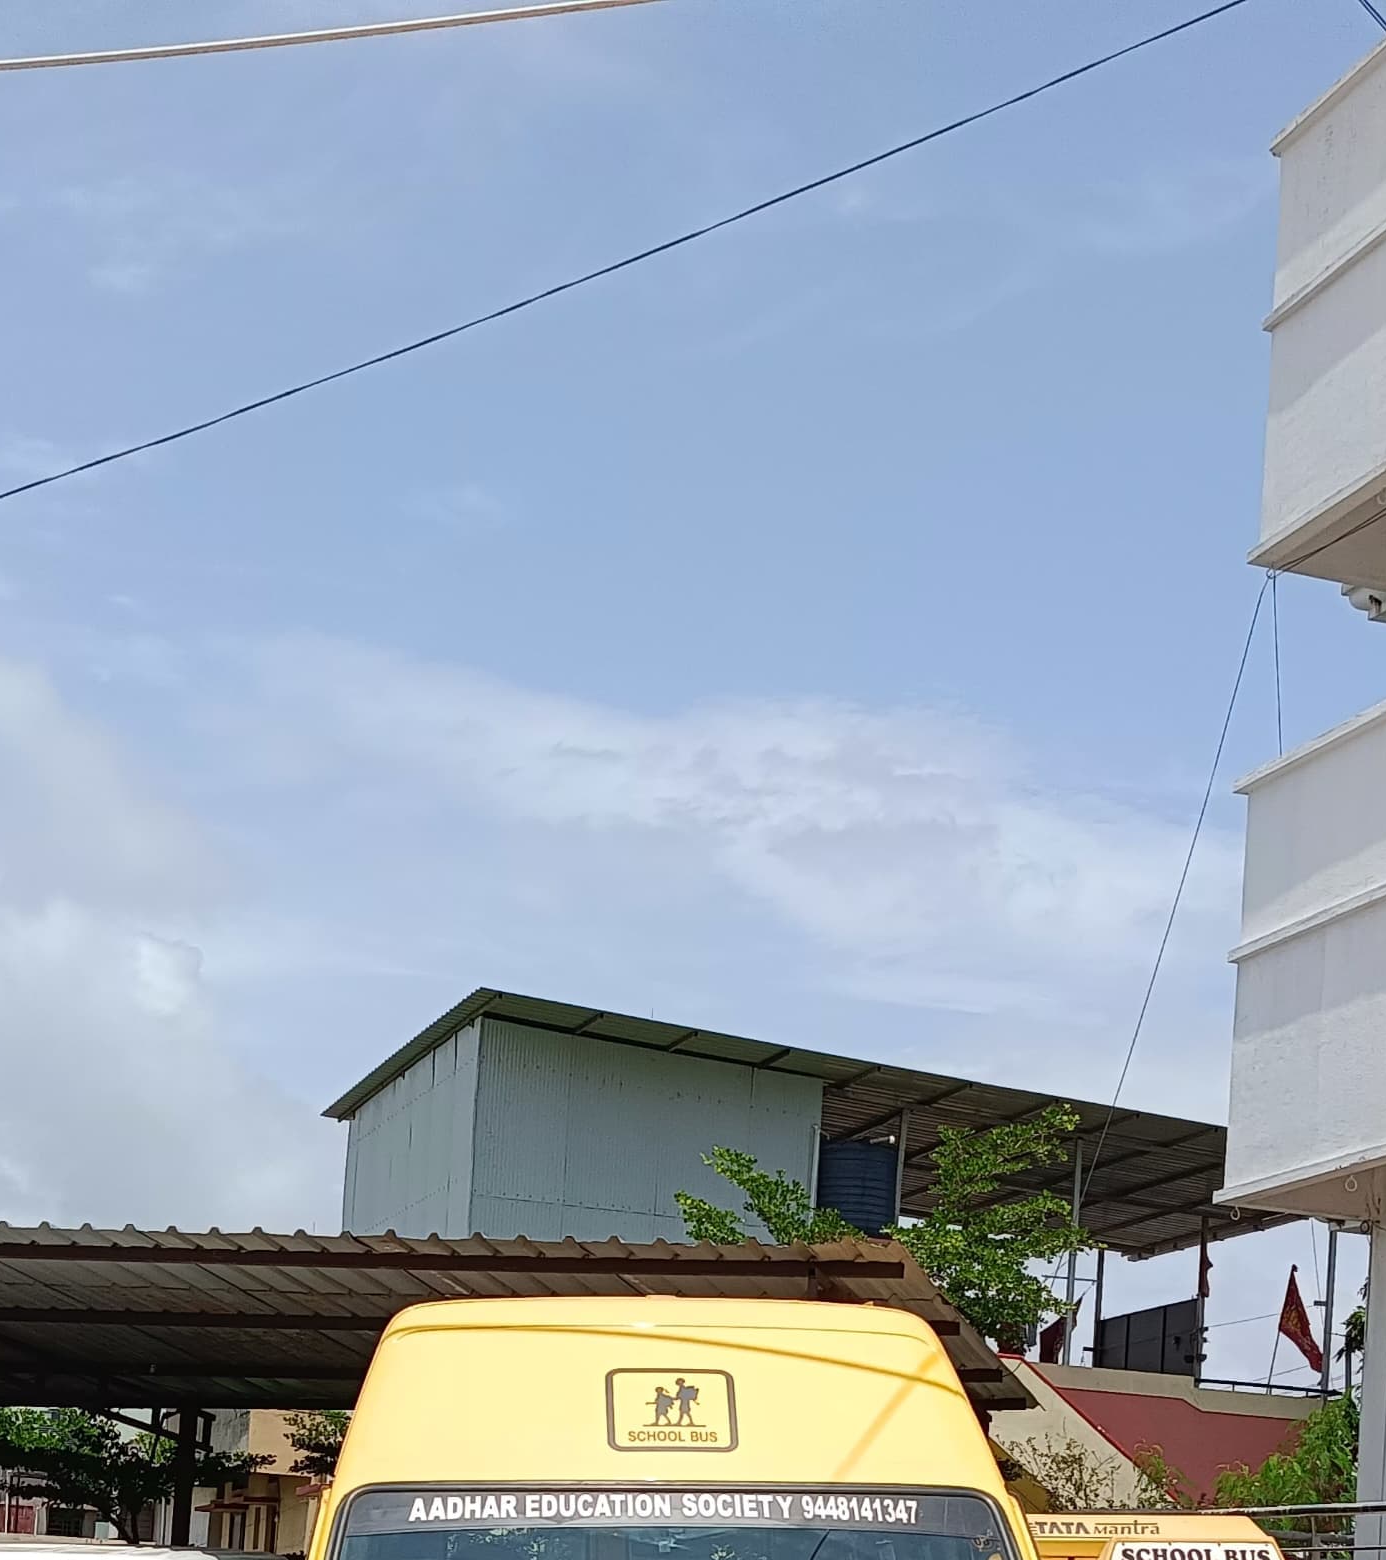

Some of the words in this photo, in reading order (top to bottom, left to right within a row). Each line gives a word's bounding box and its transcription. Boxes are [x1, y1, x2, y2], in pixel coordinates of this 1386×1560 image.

[628, 1431, 686, 1442] SCHOOL
[690, 1431, 718, 1442] BUS
[408, 1495, 518, 1522] AADHAR
[525, 1494, 671, 1518] EDUCATION
[681, 1493, 793, 1519] SOCIETY
[801, 1496, 918, 1524] 9448141347
[1034, 1521, 1091, 1535] TATA
